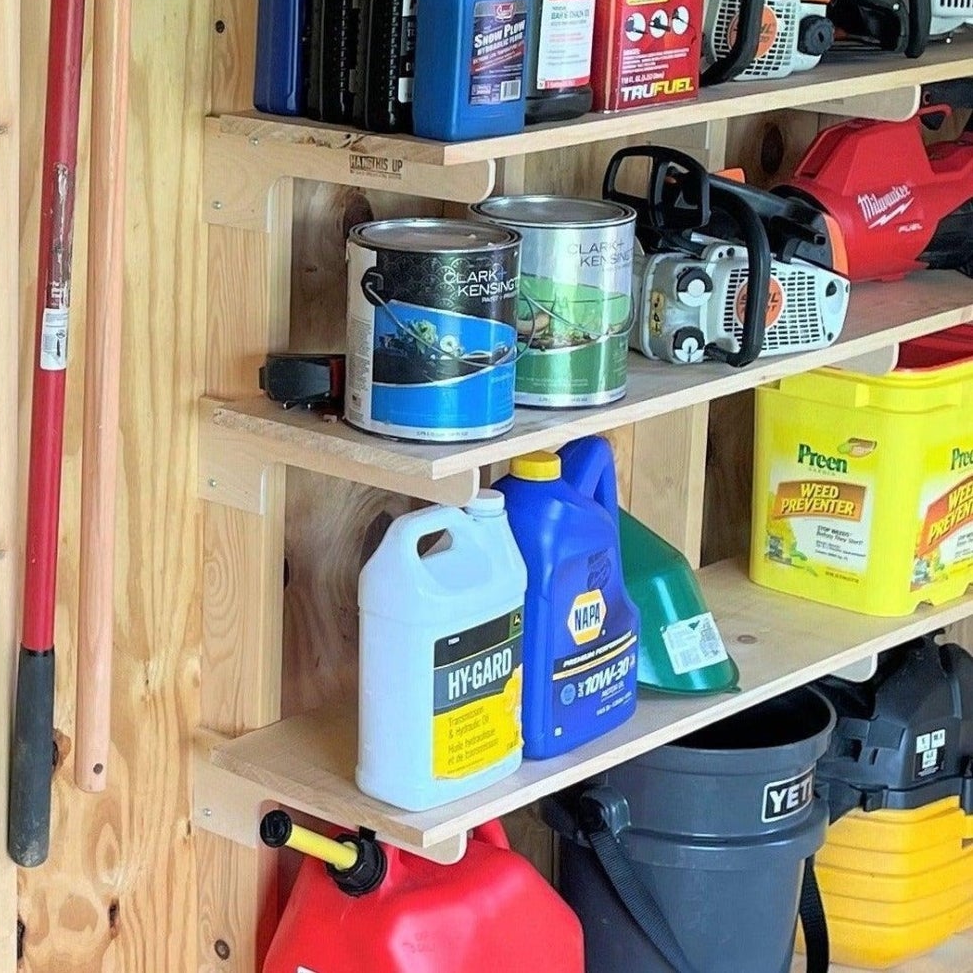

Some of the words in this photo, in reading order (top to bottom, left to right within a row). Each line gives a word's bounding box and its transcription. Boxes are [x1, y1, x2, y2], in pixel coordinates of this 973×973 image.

[621, 77, 694, 102] TRUFUEL
[858, 185, 911, 222] Milwaukee
[798, 443, 848, 474] Preen
[801, 483, 840, 499] WEED
[948, 481, 973, 510] WEE
[781, 497, 856, 517] PREVENTER
[574, 602, 601, 632] NAPA
[448, 647, 512, 700] HY-GARD
[563, 650, 595, 668] PREMIUM
[584, 656, 629, 698] 10W-30
[769, 774, 813, 813] YETI
